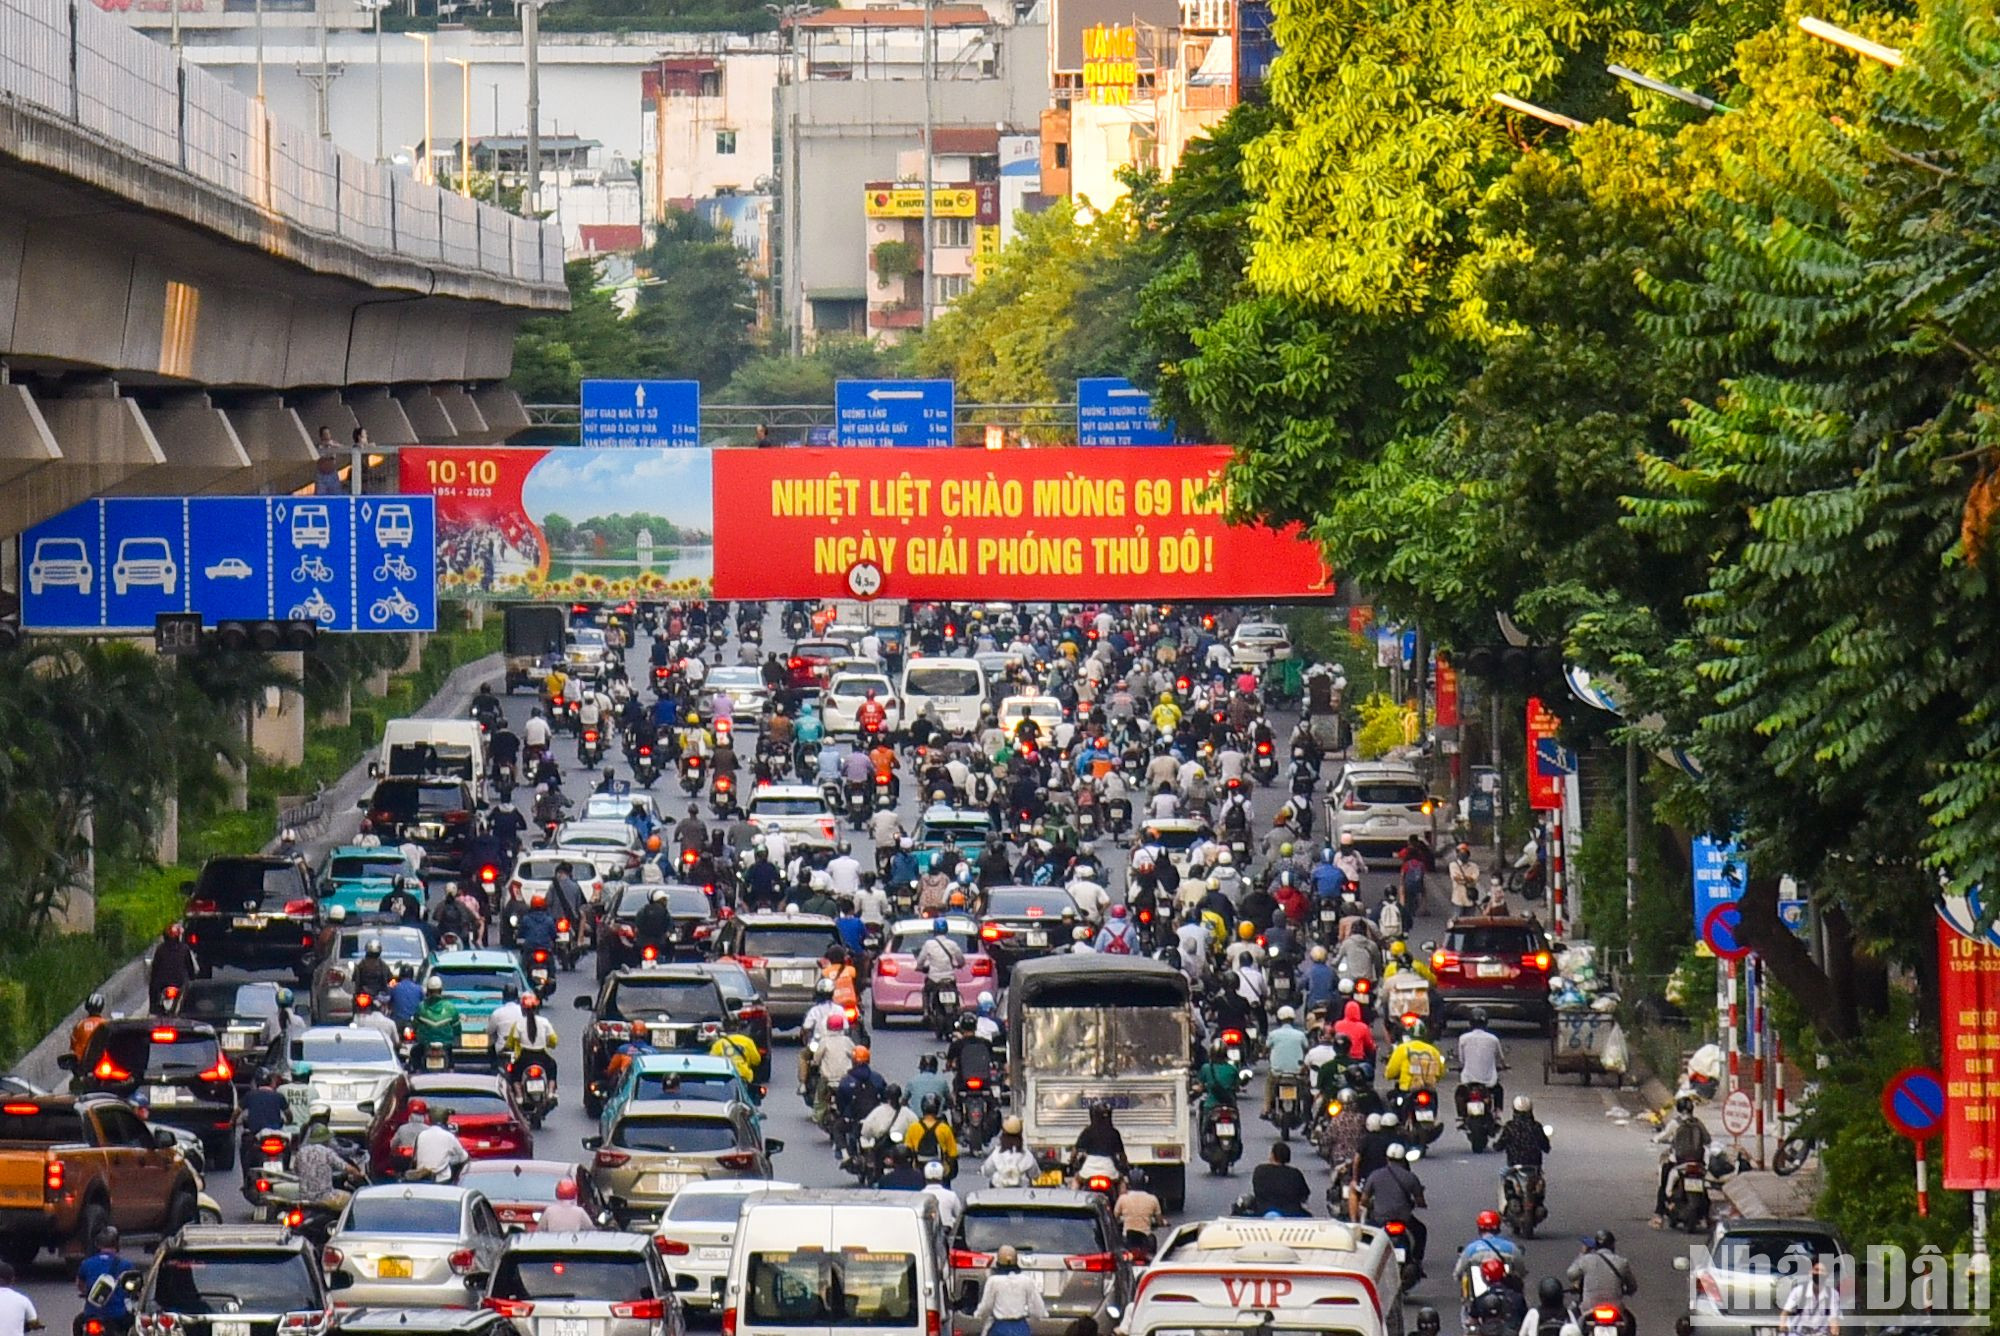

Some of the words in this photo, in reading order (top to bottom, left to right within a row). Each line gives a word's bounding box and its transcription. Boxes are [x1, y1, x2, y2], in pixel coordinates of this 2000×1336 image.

[936, 408, 948, 418] km
[684, 424, 696, 434] km
[936, 423, 948, 433] km
[432, 487, 456, 497] 1954
[466, 487, 492, 497] 2023
[771, 471, 860, 524] NHIỆT
[870, 471, 931, 524] LIỆT
[941, 471, 1023, 517] CHÀO
[1033, 472, 1125, 517] MỪNG
[1135, 479, 1172, 517] 69
[1182, 470, 1234, 515] NĂ
[814, 529, 897, 574] NGÀY
[907, 525, 967, 575] GIẢI
[978, 530, 1082, 575] PHÓNG
[1092, 524, 1149, 574] THỦ
[1159, 528, 1213, 573] ĐÔ!
[1221, 1278, 1292, 1308] VIP
